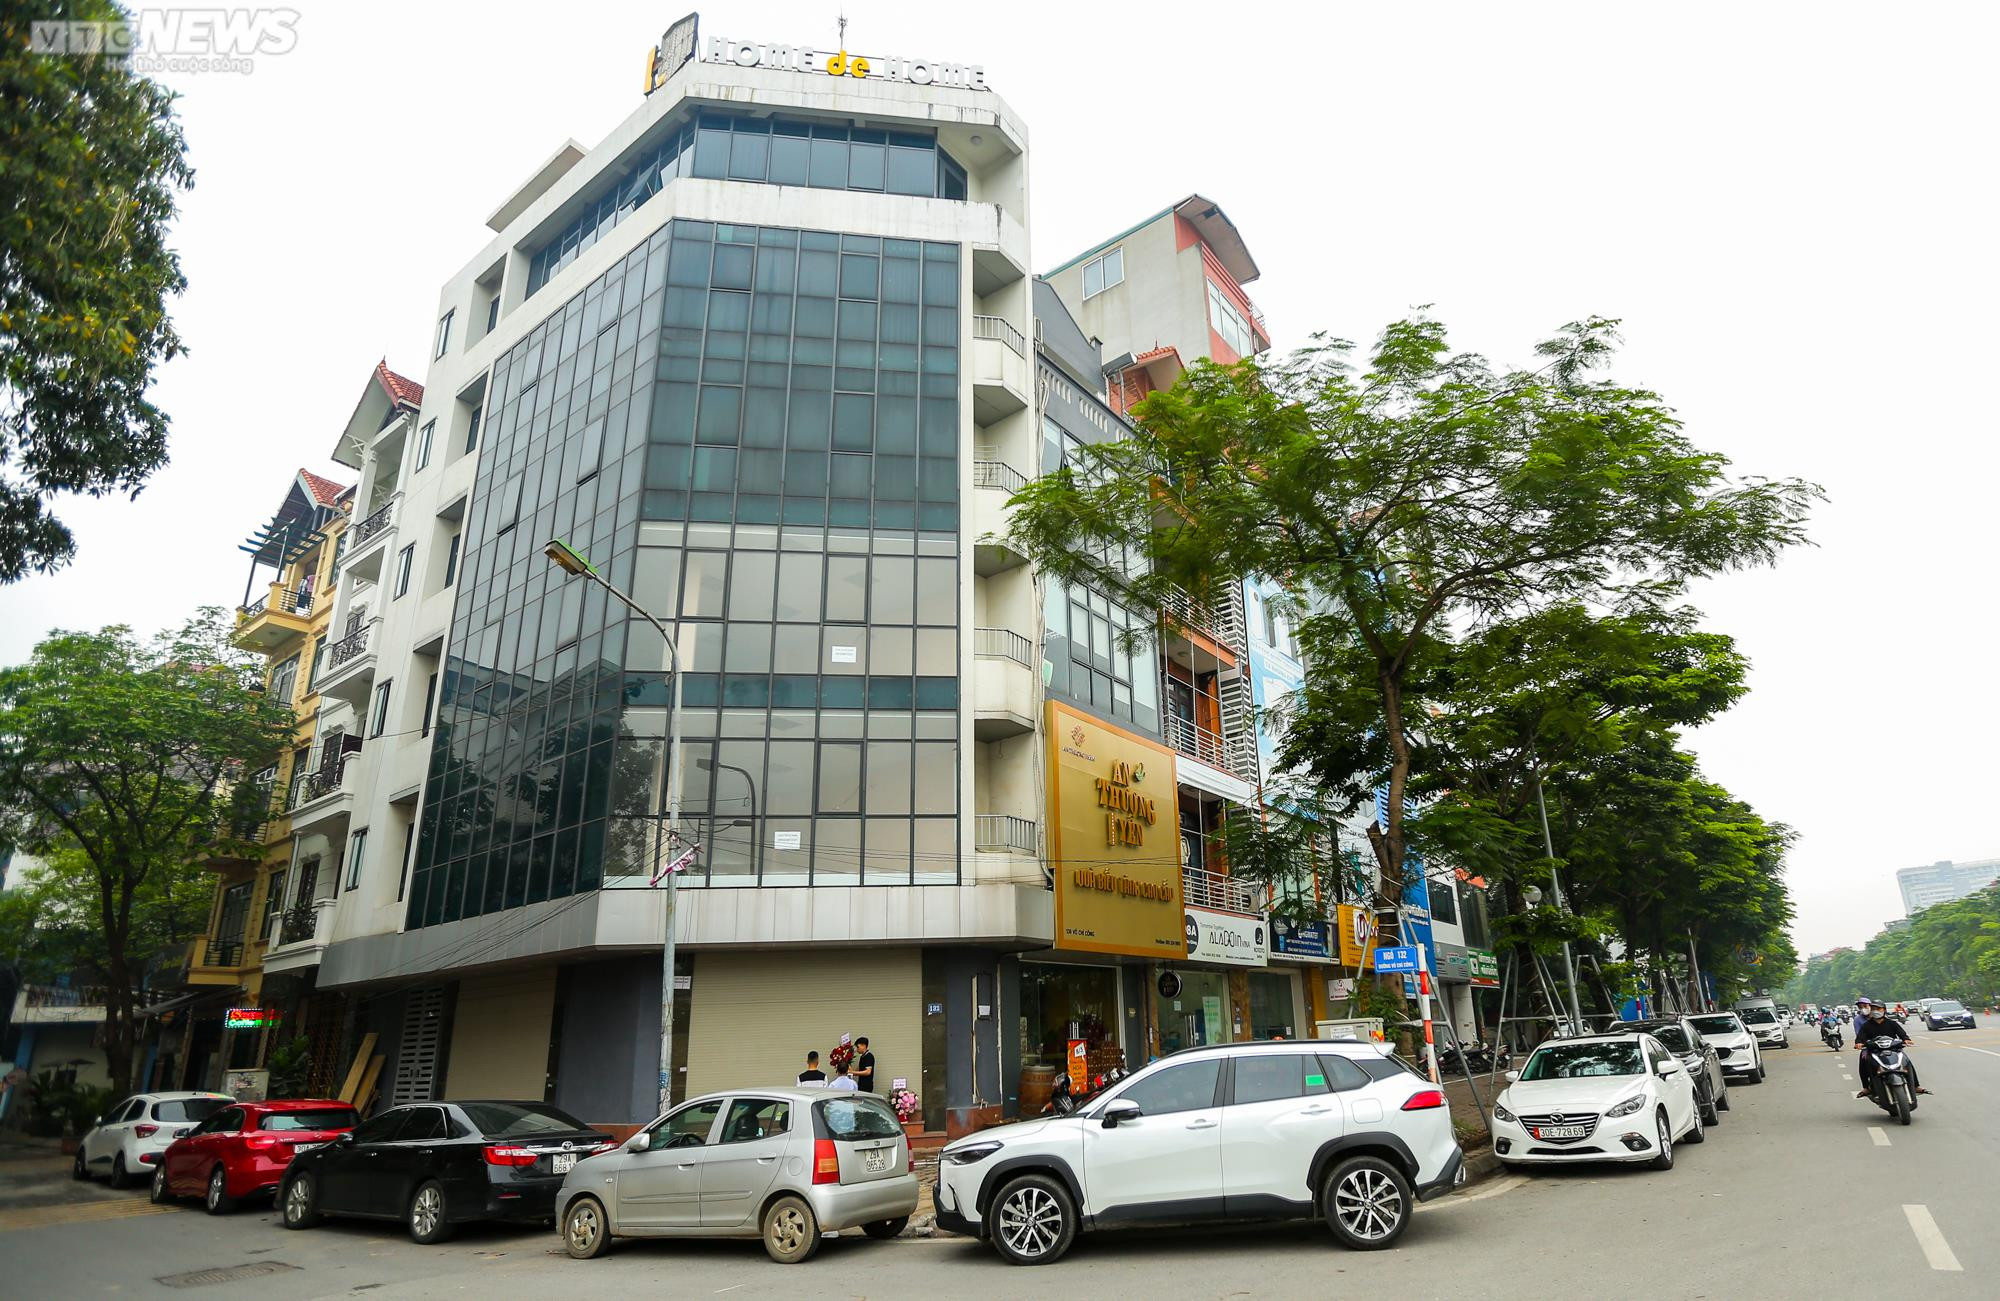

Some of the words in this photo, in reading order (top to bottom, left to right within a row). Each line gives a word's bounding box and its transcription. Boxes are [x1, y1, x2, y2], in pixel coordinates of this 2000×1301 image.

[706, 36, 813, 73] HOME
[826, 49, 870, 78] de
[884, 55, 985, 92] HOME
[1111, 759, 1130, 787] AN
[1383, 950, 1394, 960] NGÕ
[1397, 950, 1408, 959] 132
[559, 1154, 572, 1163] 29A
